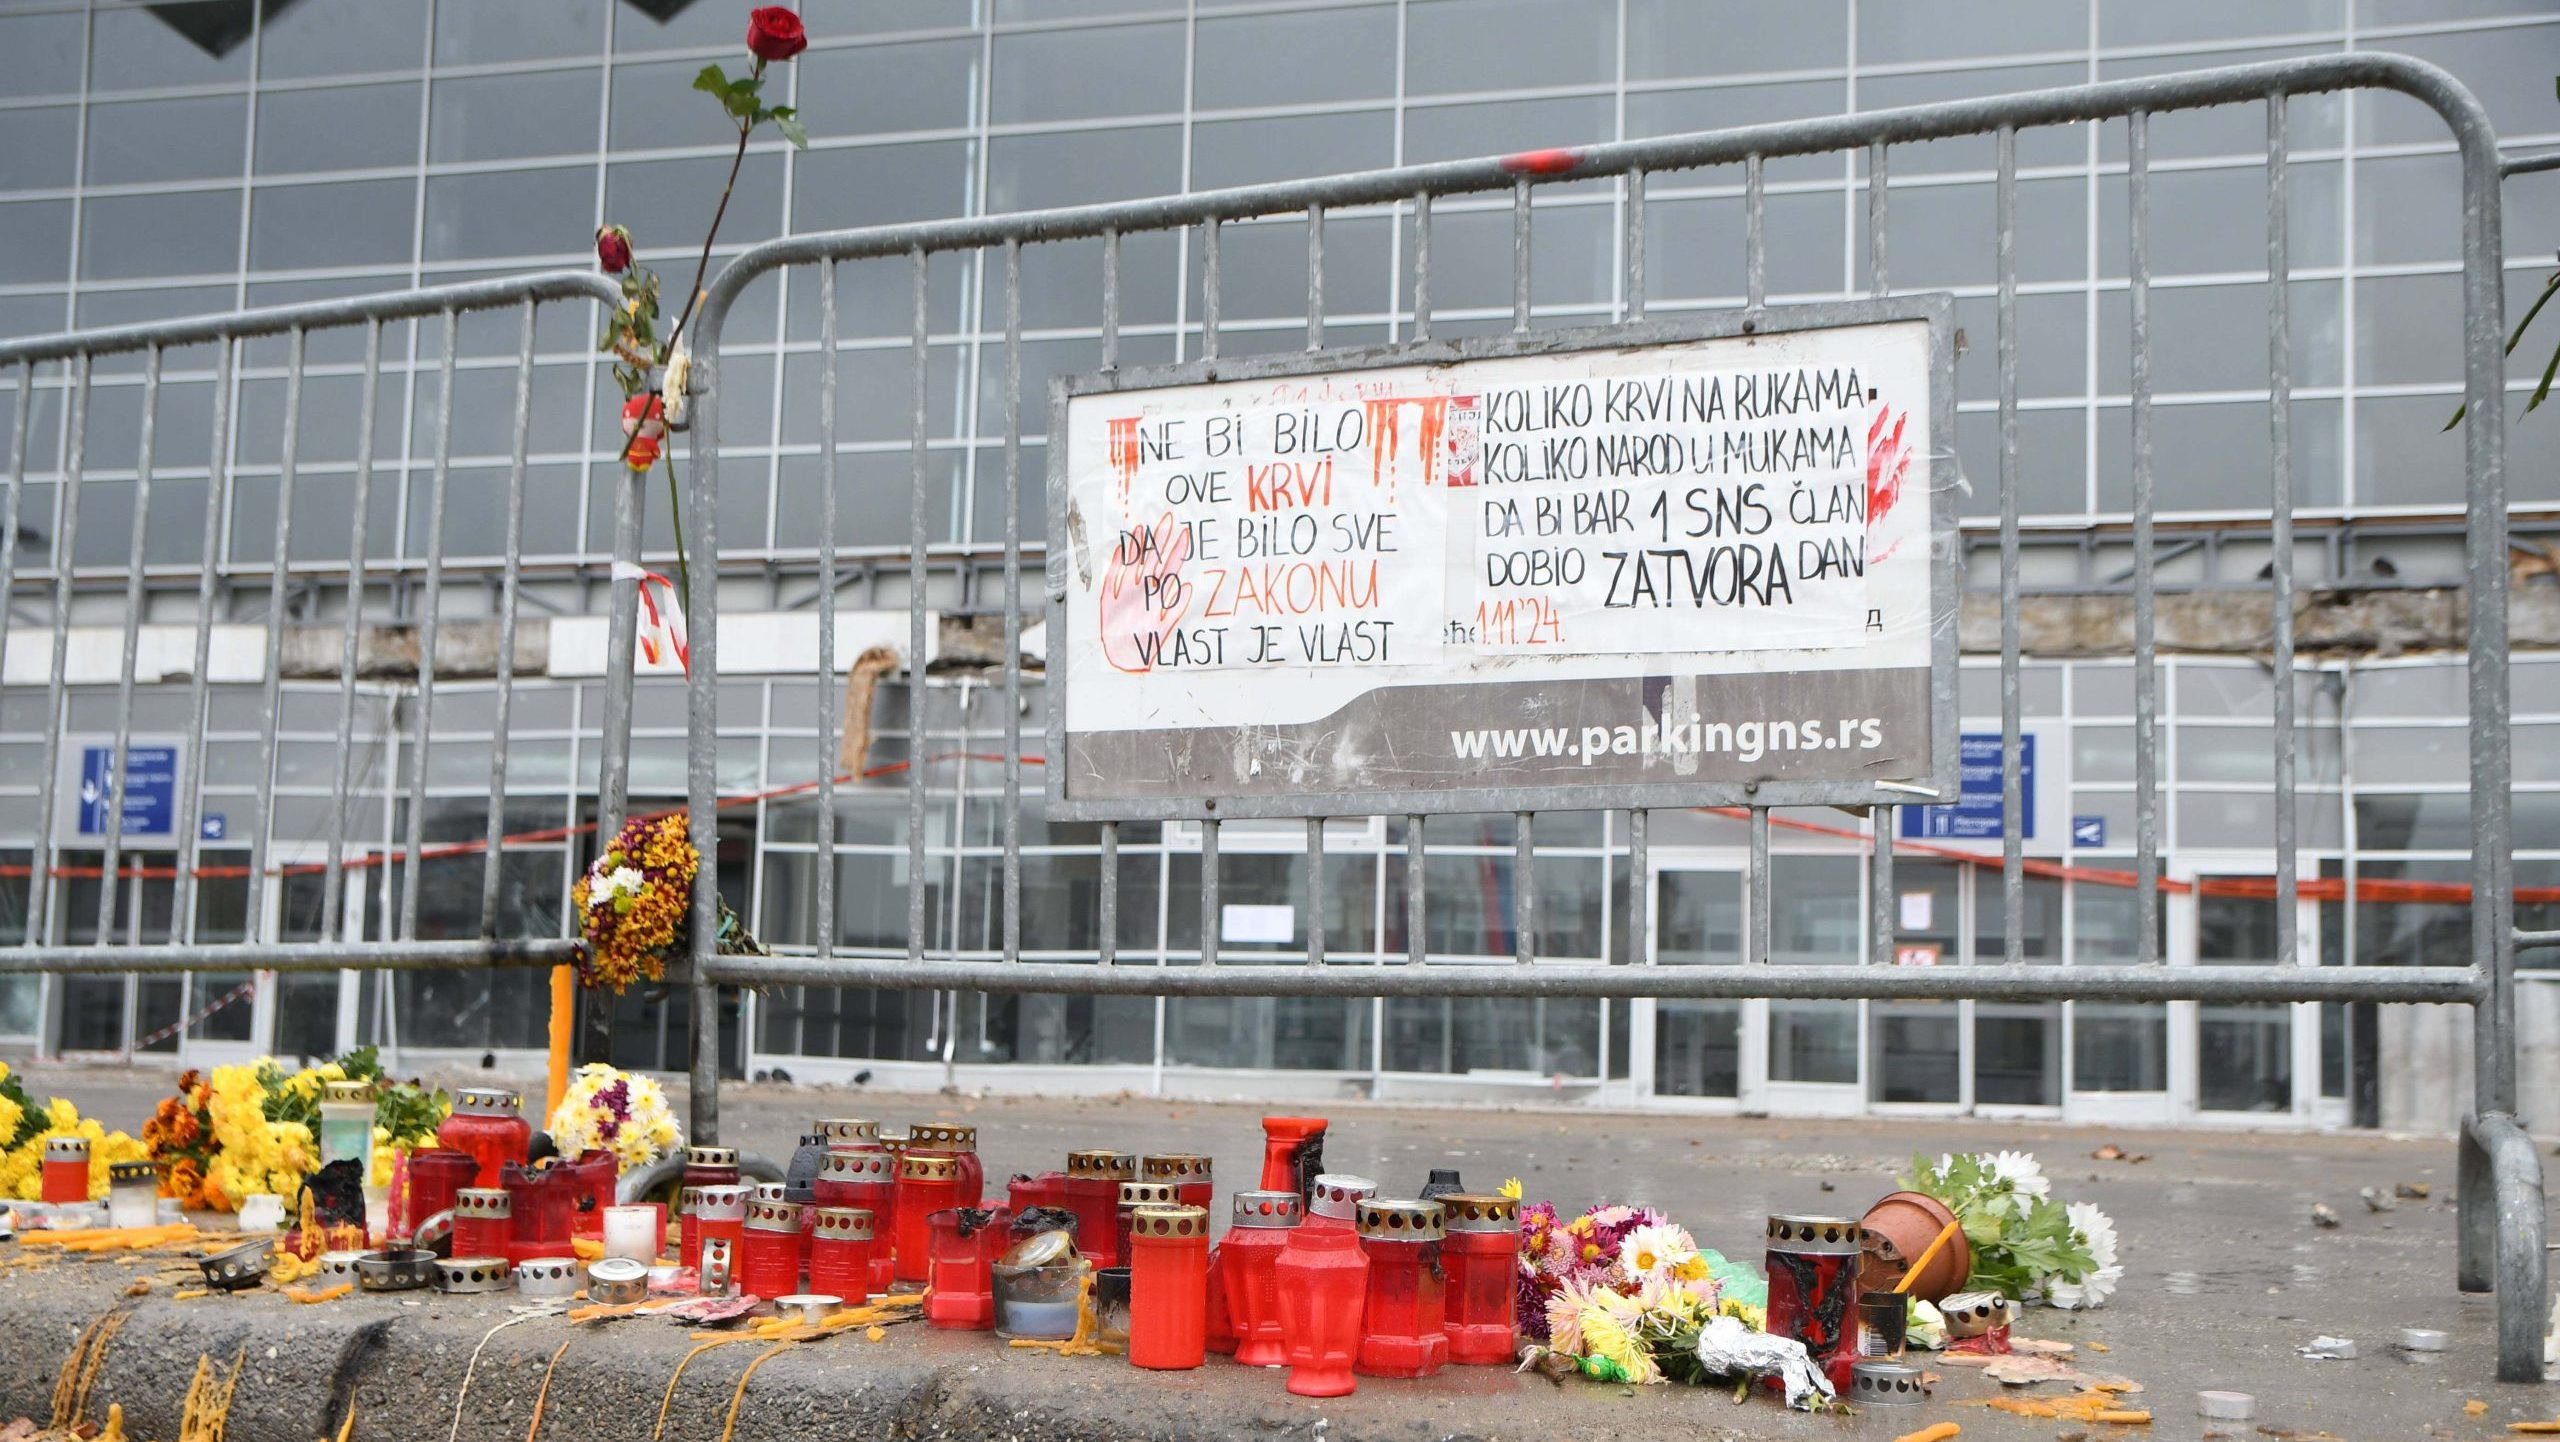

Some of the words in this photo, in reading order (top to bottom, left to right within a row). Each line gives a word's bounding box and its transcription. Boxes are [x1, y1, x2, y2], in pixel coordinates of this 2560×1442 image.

[1683, 377, 1724, 424] NA
[1734, 367, 1865, 419] RUKAMA
[1139, 420, 1186, 465] NE
[1597, 433, 1684, 478] NAROD
[1723, 425, 1856, 475] MUKAMA
[1165, 471, 1232, 505] OVE
[1485, 498, 1524, 539] DA
[1536, 495, 1562, 534] BI
[1574, 488, 1635, 536] BAR
[1650, 489, 1669, 543] 1
[1685, 483, 1773, 539] SNS
[1789, 480, 1866, 526] ČLAN
[1119, 525, 1163, 567] DA
[1181, 518, 1220, 562] JE
[1332, 512, 1399, 554] SVE
[1143, 572, 1182, 612] PO
[1203, 559, 1380, 618] ZAKONU
[1602, 542, 1794, 608] ZATVORA
[1799, 535, 1865, 581] DAN
[1132, 628, 1229, 667] VLAST
[1246, 626, 1286, 663] JE
[1299, 620, 1394, 663] VLAST
[1451, 712, 1882, 766] www.parkingns.rs
